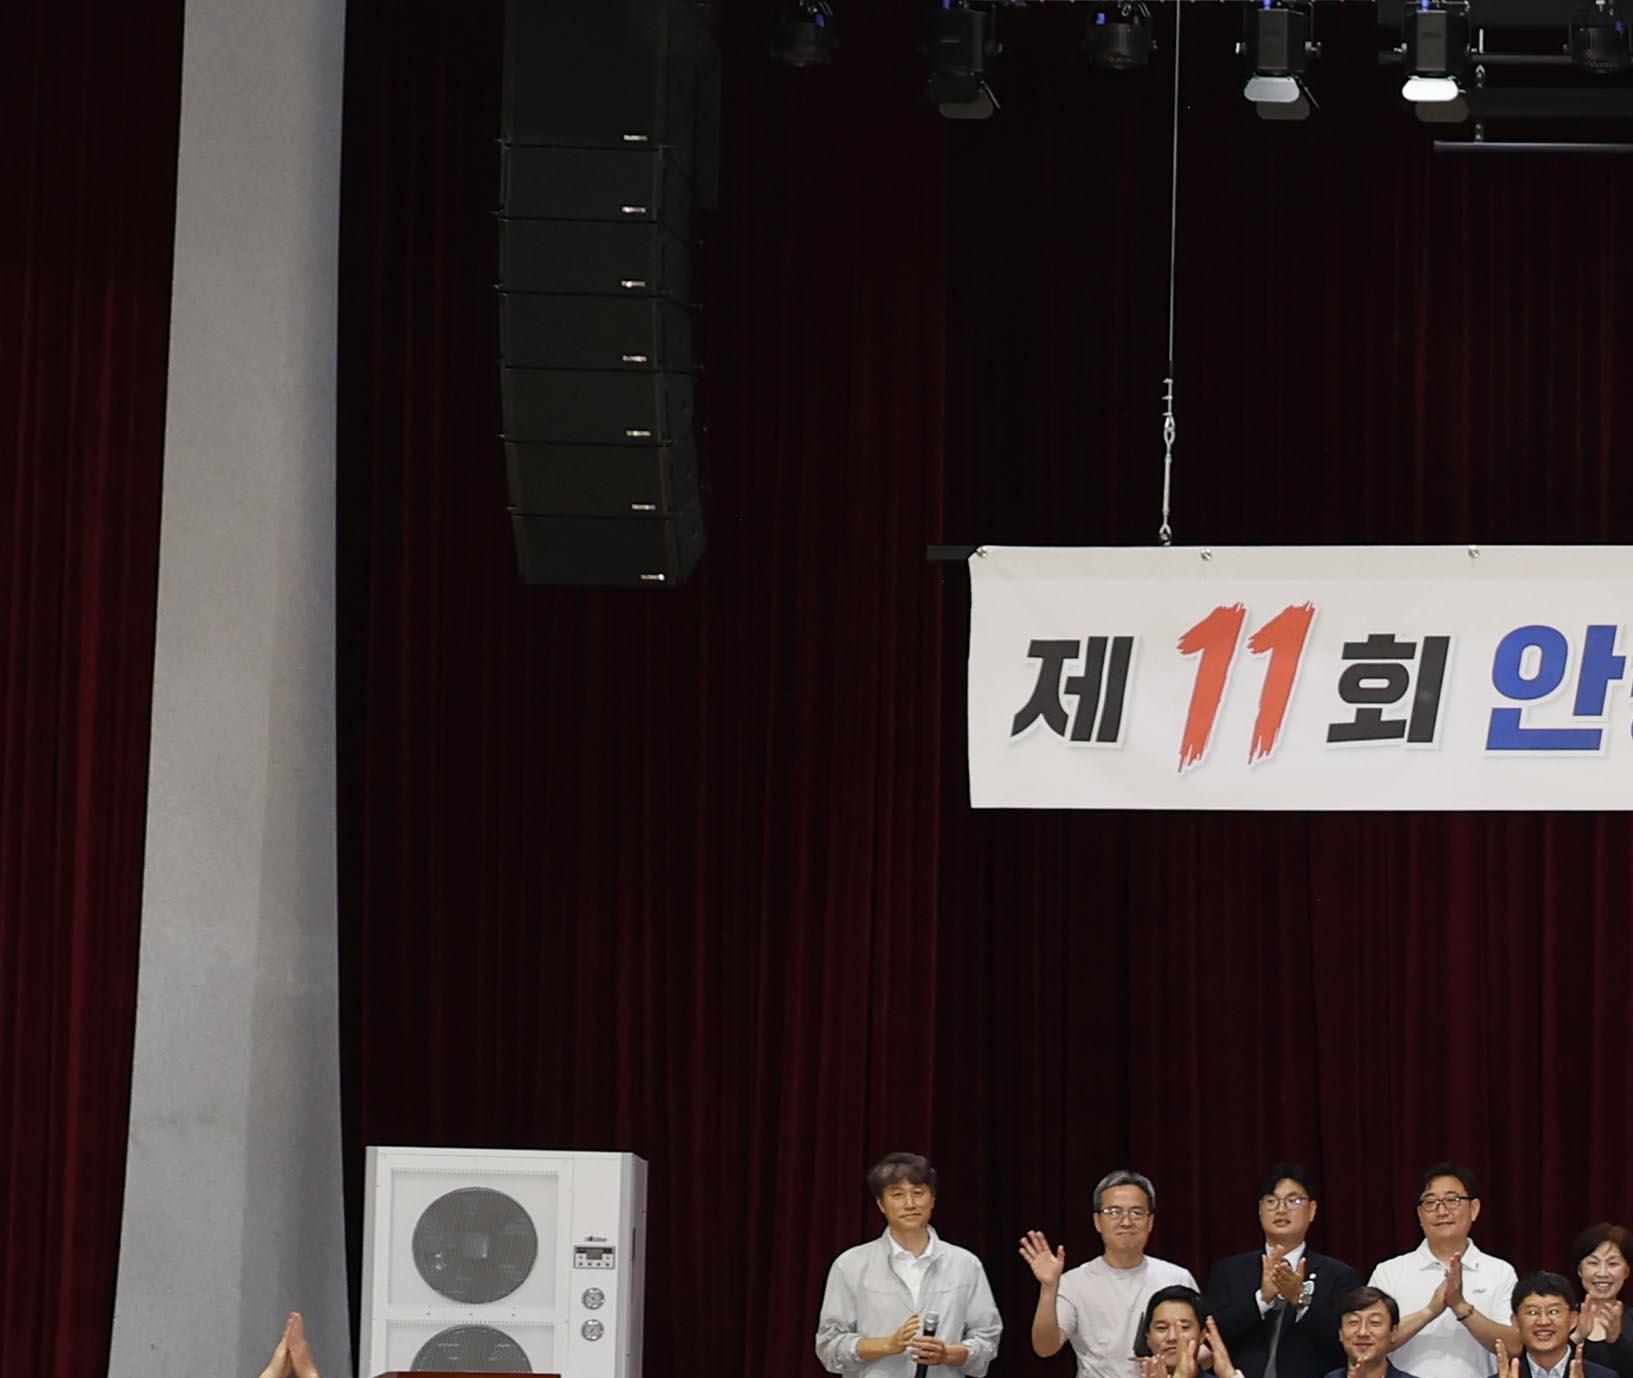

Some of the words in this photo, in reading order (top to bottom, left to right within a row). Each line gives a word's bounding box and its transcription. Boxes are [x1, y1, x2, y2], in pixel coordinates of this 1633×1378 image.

[1010, 632, 1136, 747] 제
[1174, 600, 1317, 773] 11
[1325, 632, 1451, 746] 회
